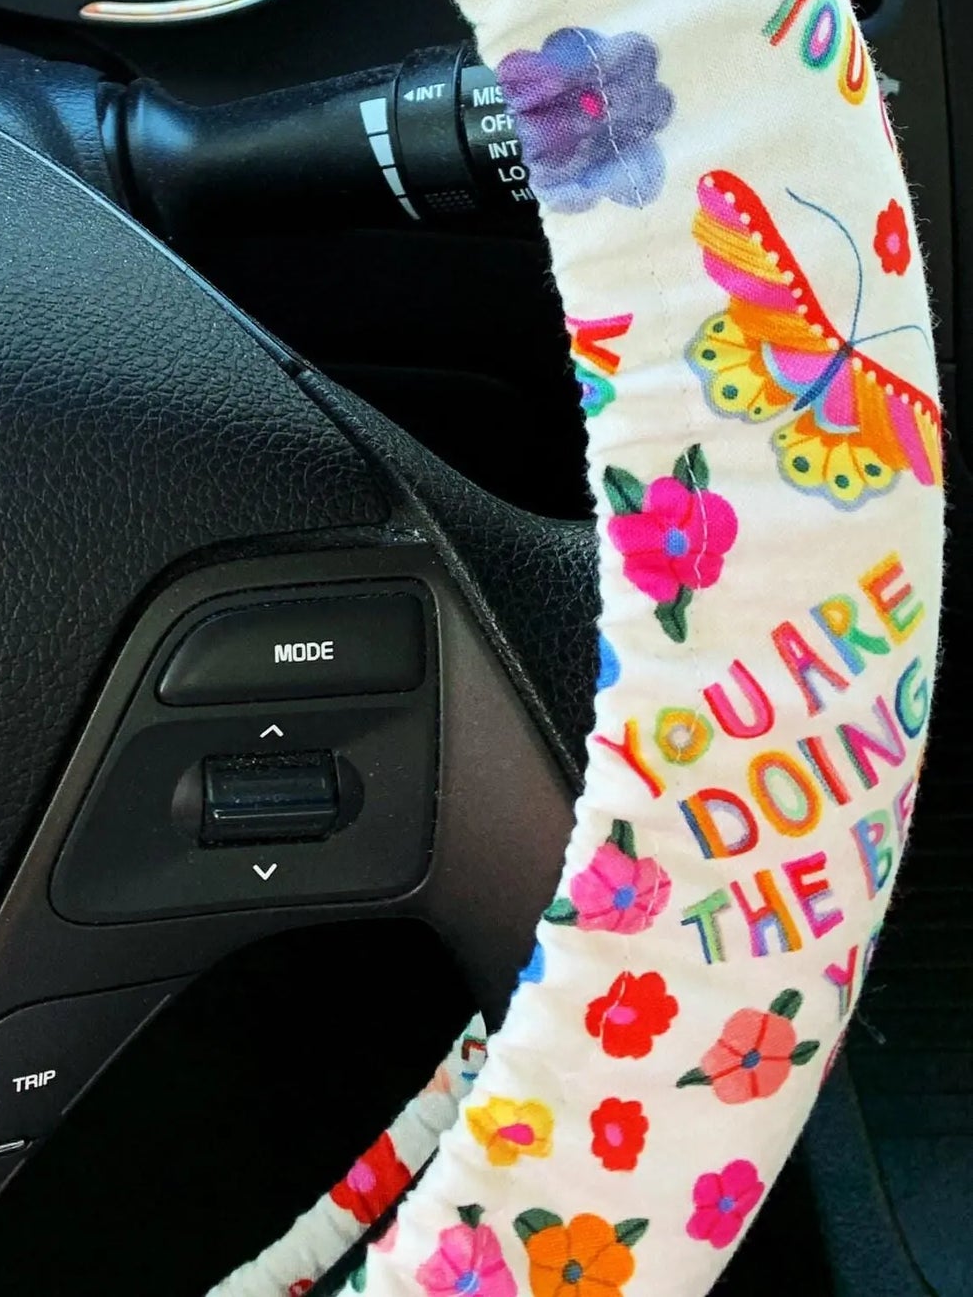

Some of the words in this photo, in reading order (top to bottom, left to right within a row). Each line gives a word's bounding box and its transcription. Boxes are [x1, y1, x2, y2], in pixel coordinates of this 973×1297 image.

[416, 83, 447, 102] INT
[488, 139, 519, 160] INT
[498, 165, 527, 183] LO
[273, 640, 335, 664] MODE
[594, 658, 776, 799] YOU
[770, 550, 926, 718] ARE
[676, 655, 929, 859] DOING
[681, 850, 845, 965] THE
[11, 1069, 57, 1094] TRIP
